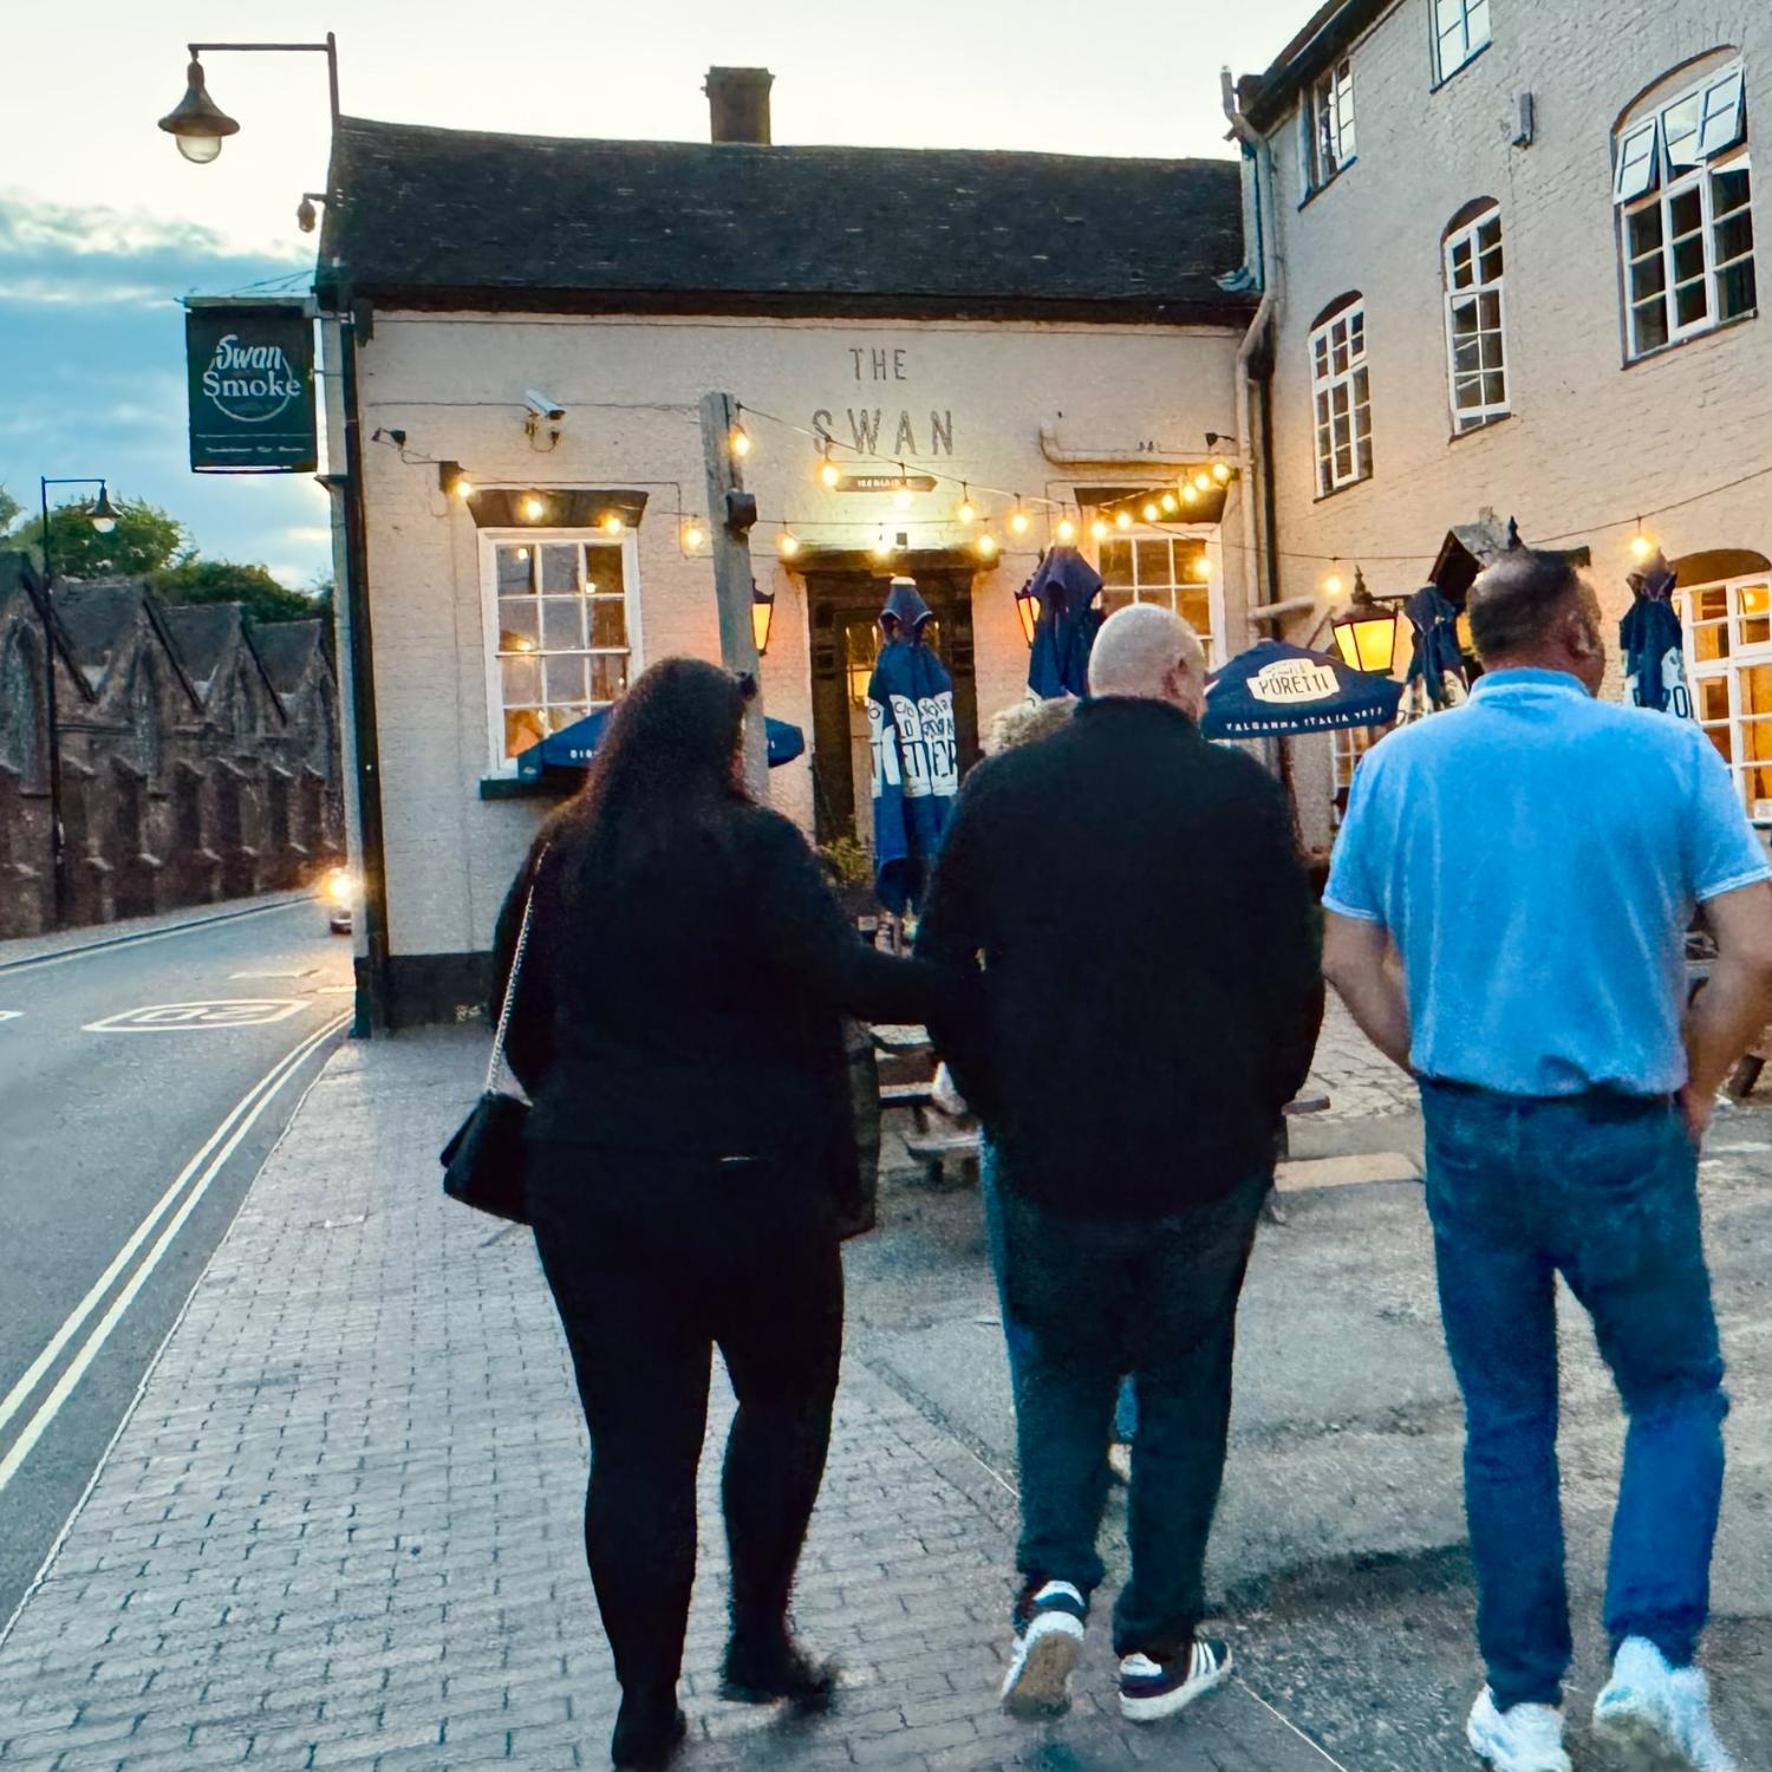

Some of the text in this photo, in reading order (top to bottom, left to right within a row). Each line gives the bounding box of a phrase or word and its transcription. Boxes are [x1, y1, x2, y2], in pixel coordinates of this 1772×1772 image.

[216, 334, 282, 370] Swan
[848, 348, 907, 381] THE
[203, 370, 302, 397] Smoke
[812, 408, 953, 455] SWAN
[1304, 713, 1349, 727] ITALIA
